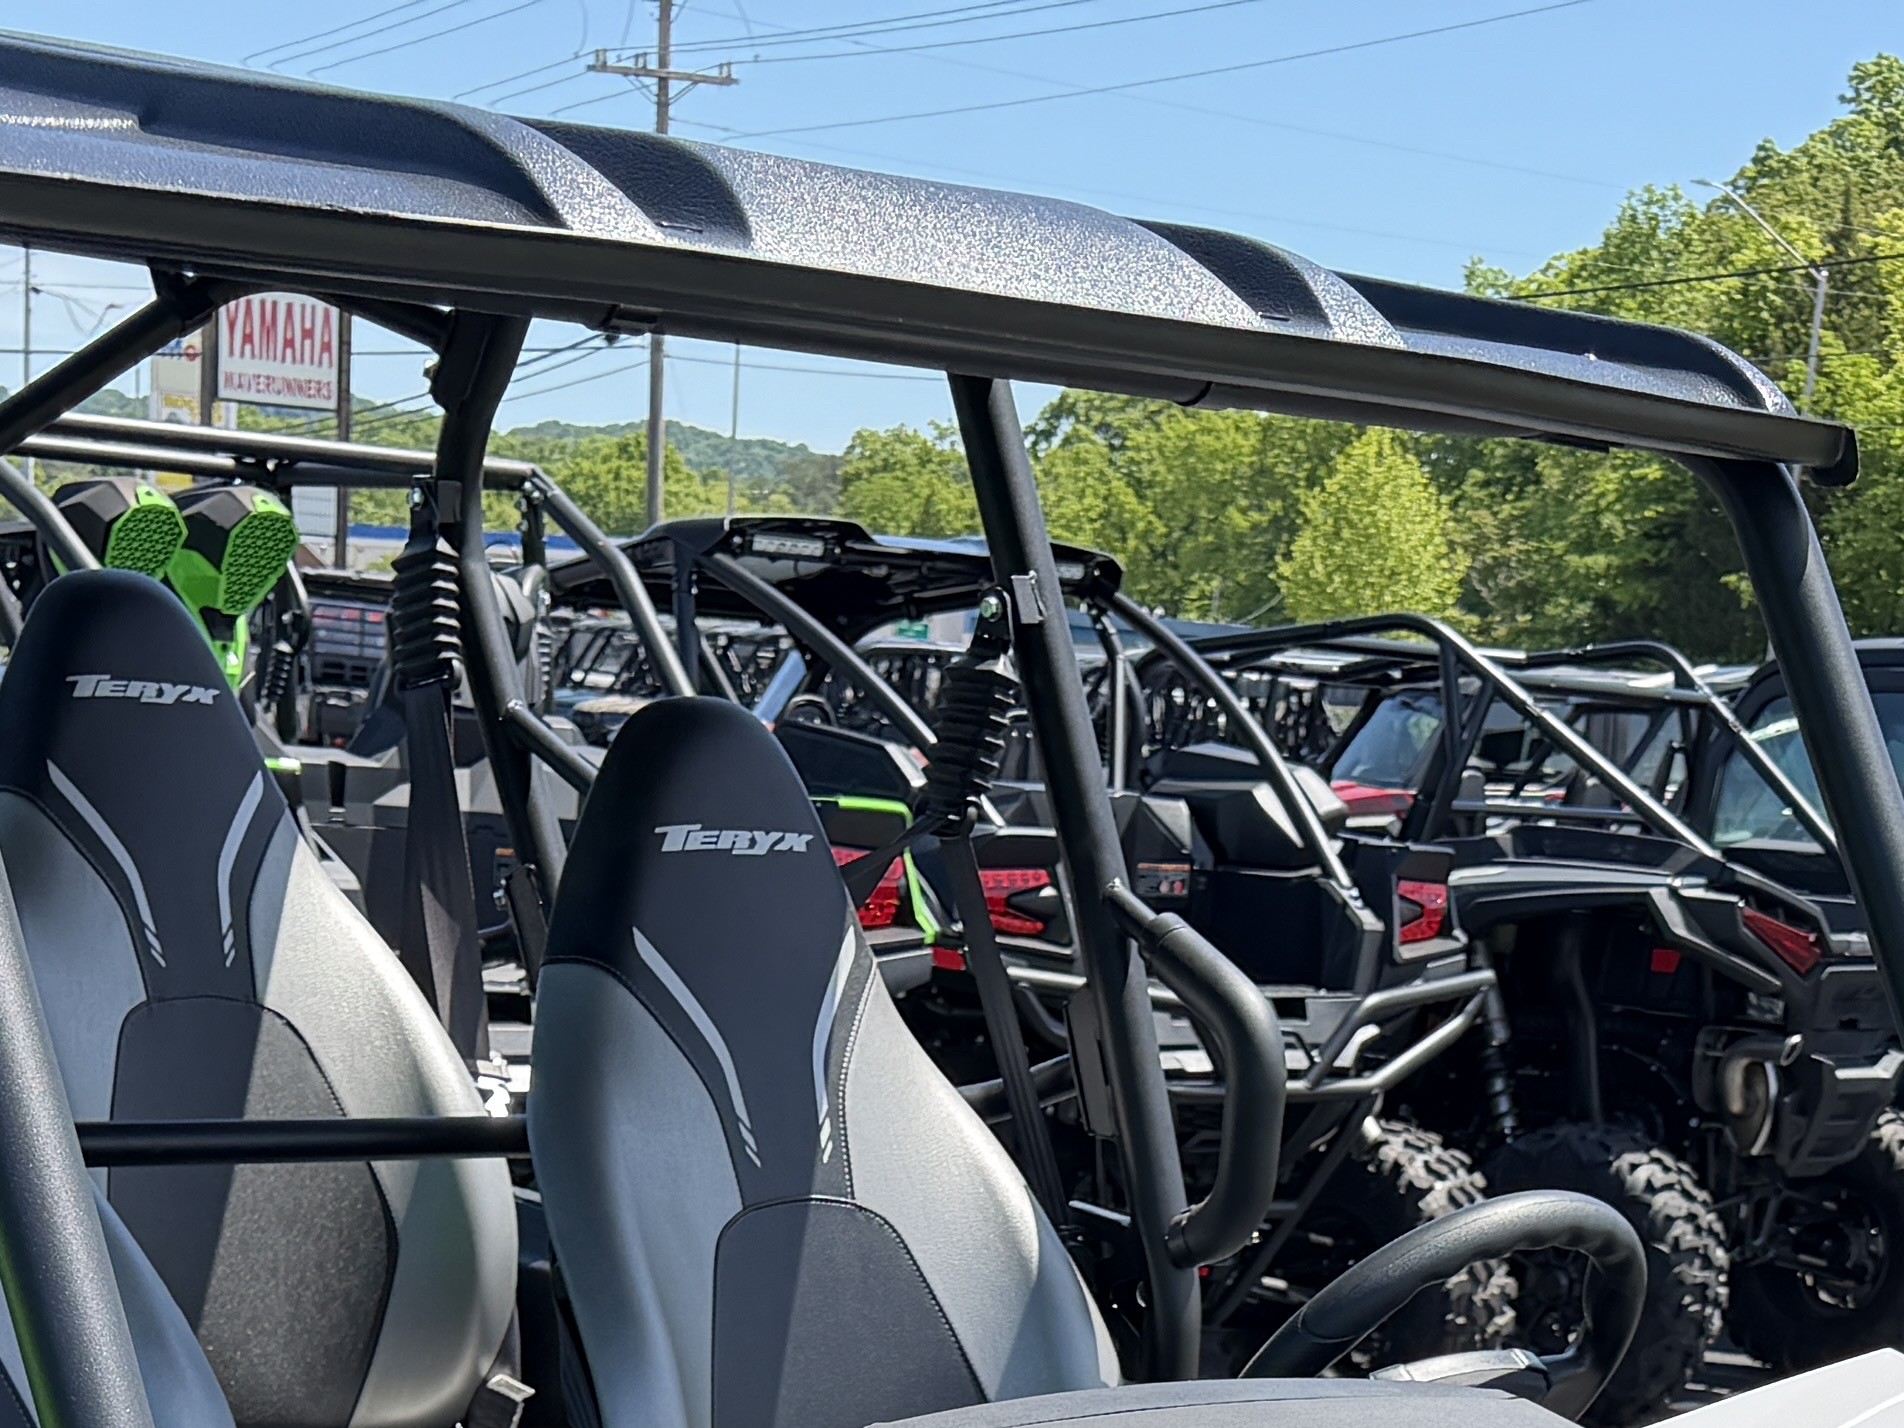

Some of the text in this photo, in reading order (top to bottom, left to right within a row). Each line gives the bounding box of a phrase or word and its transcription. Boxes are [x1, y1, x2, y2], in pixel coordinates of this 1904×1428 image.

[225, 299, 334, 369] YAMAHA
[65, 674, 221, 705] TERYX
[654, 824, 815, 855] TERYX
